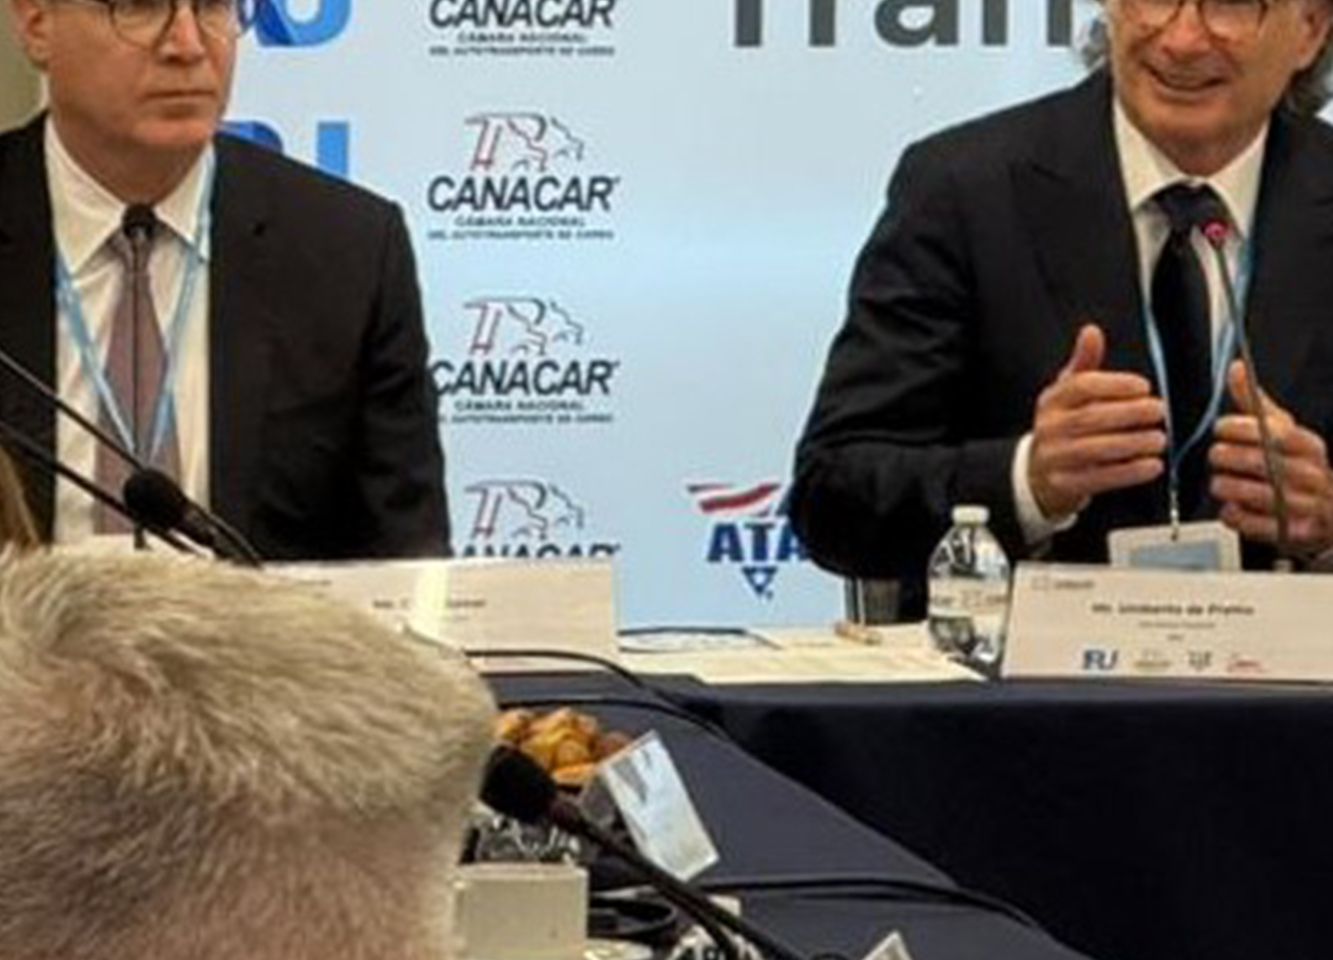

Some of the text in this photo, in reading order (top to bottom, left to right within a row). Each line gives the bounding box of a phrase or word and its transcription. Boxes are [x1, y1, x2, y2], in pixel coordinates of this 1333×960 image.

[427, 175, 614, 212] CANACAR
[432, 359, 613, 396] CANACAR
[707, 523, 809, 562] ATA
